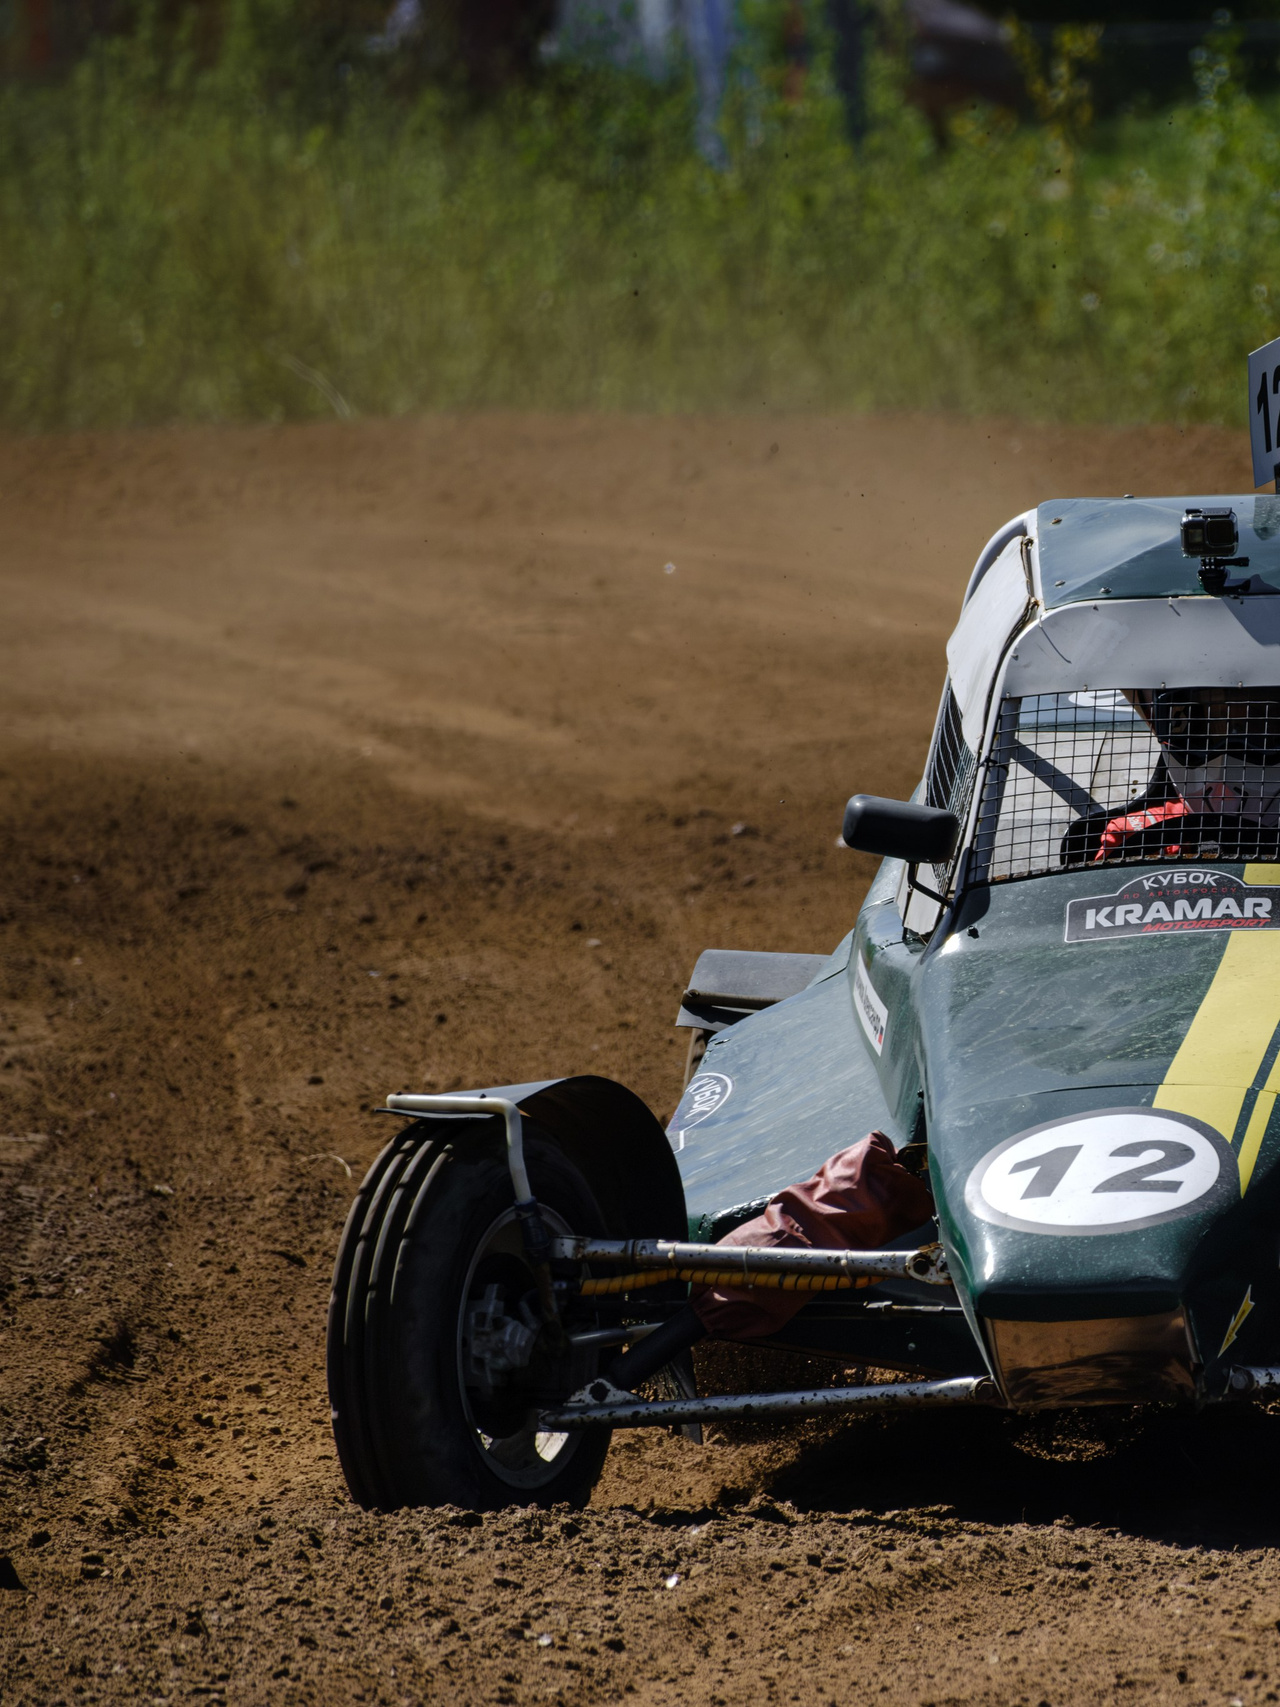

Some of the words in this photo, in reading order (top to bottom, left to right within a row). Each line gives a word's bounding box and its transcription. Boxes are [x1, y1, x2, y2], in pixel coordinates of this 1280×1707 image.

[1143, 872, 1220, 890] КУБОК
[1085, 897, 1273, 930] KRAMAR
[1142, 918, 1271, 933] MOTORSPORT
[1008, 1139, 1196, 1200] 12
